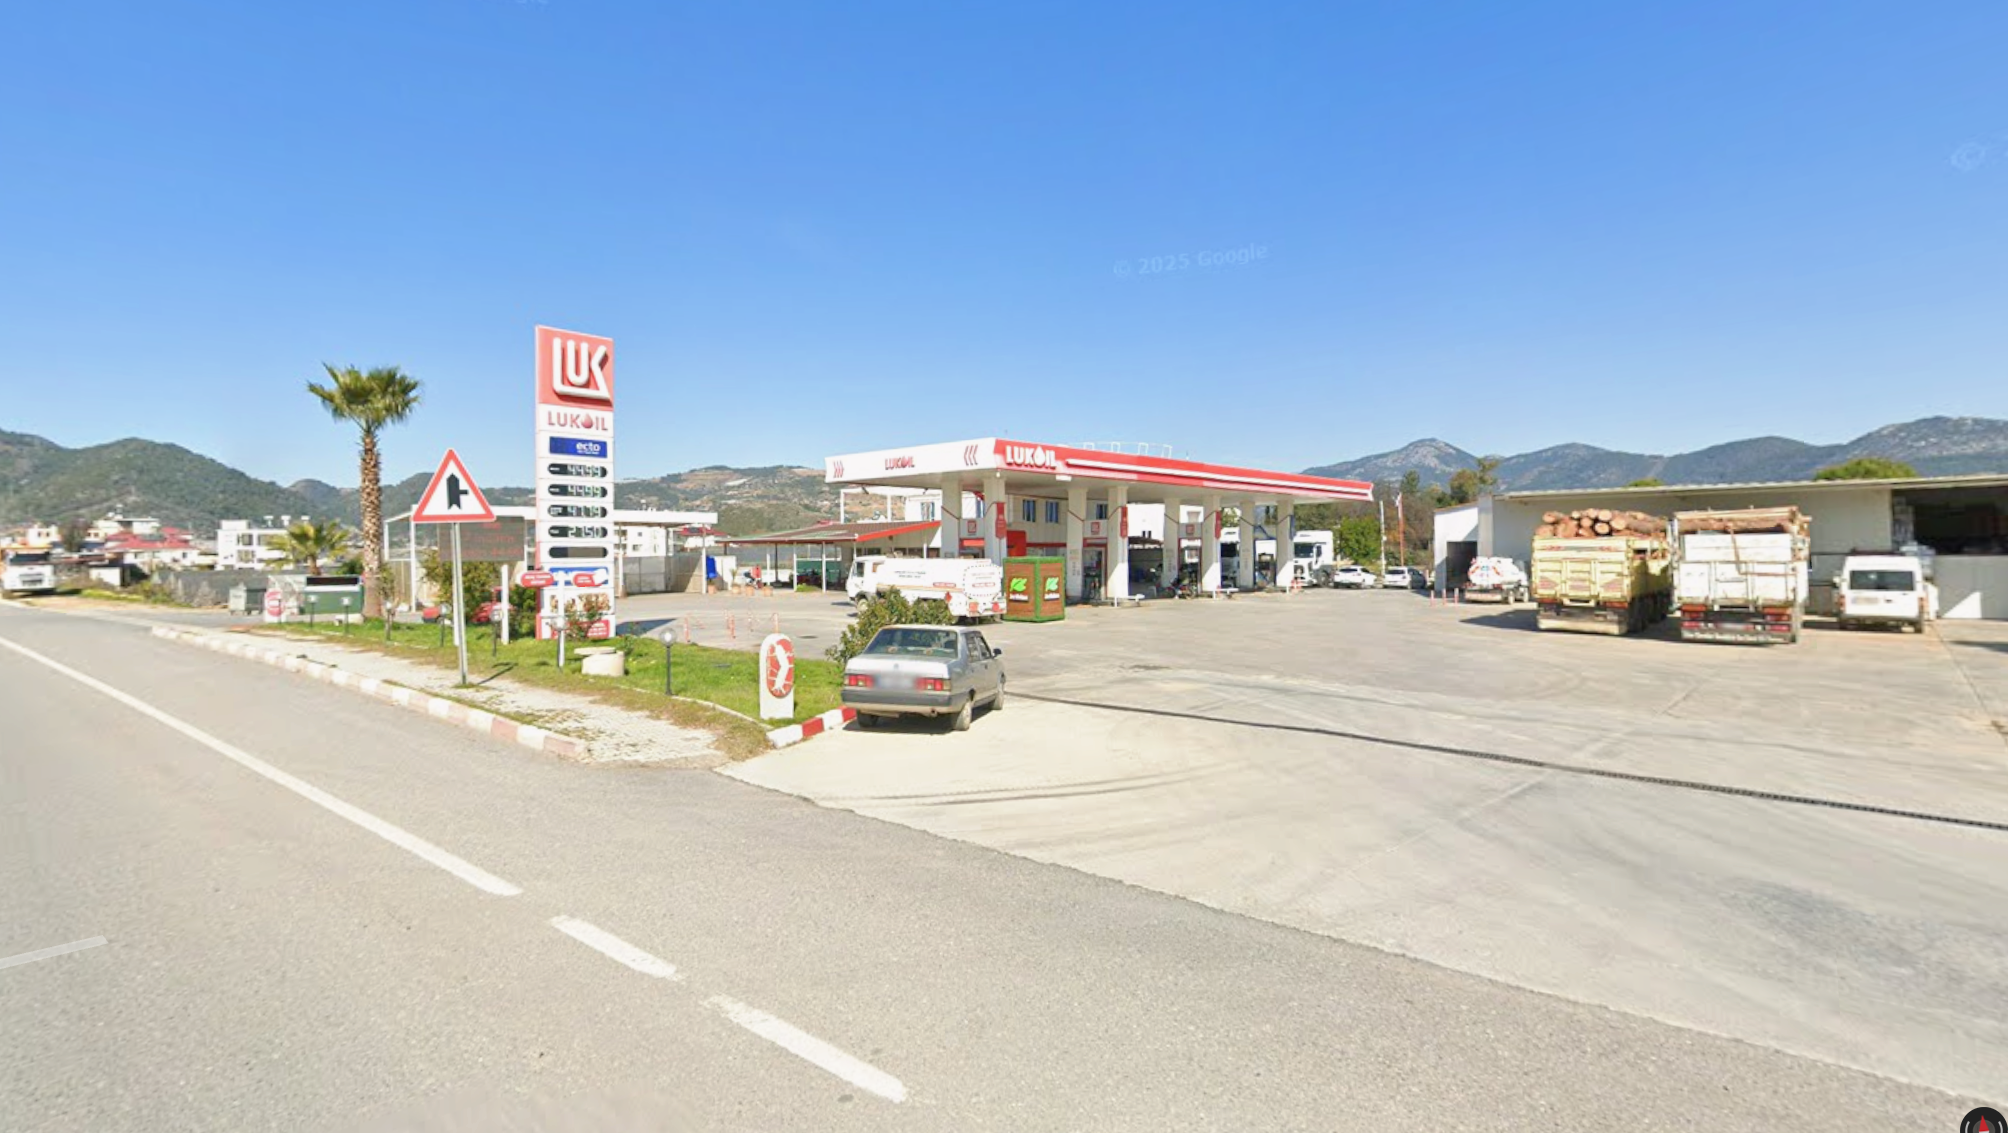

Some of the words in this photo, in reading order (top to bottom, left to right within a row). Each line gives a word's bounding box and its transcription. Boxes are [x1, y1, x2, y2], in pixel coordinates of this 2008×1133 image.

[547, 410, 609, 431] LUKOIL
[576, 441, 601, 452] ecto
[884, 456, 915, 471] LUKOIL
[1005, 445, 1057, 469] LUKOIL
